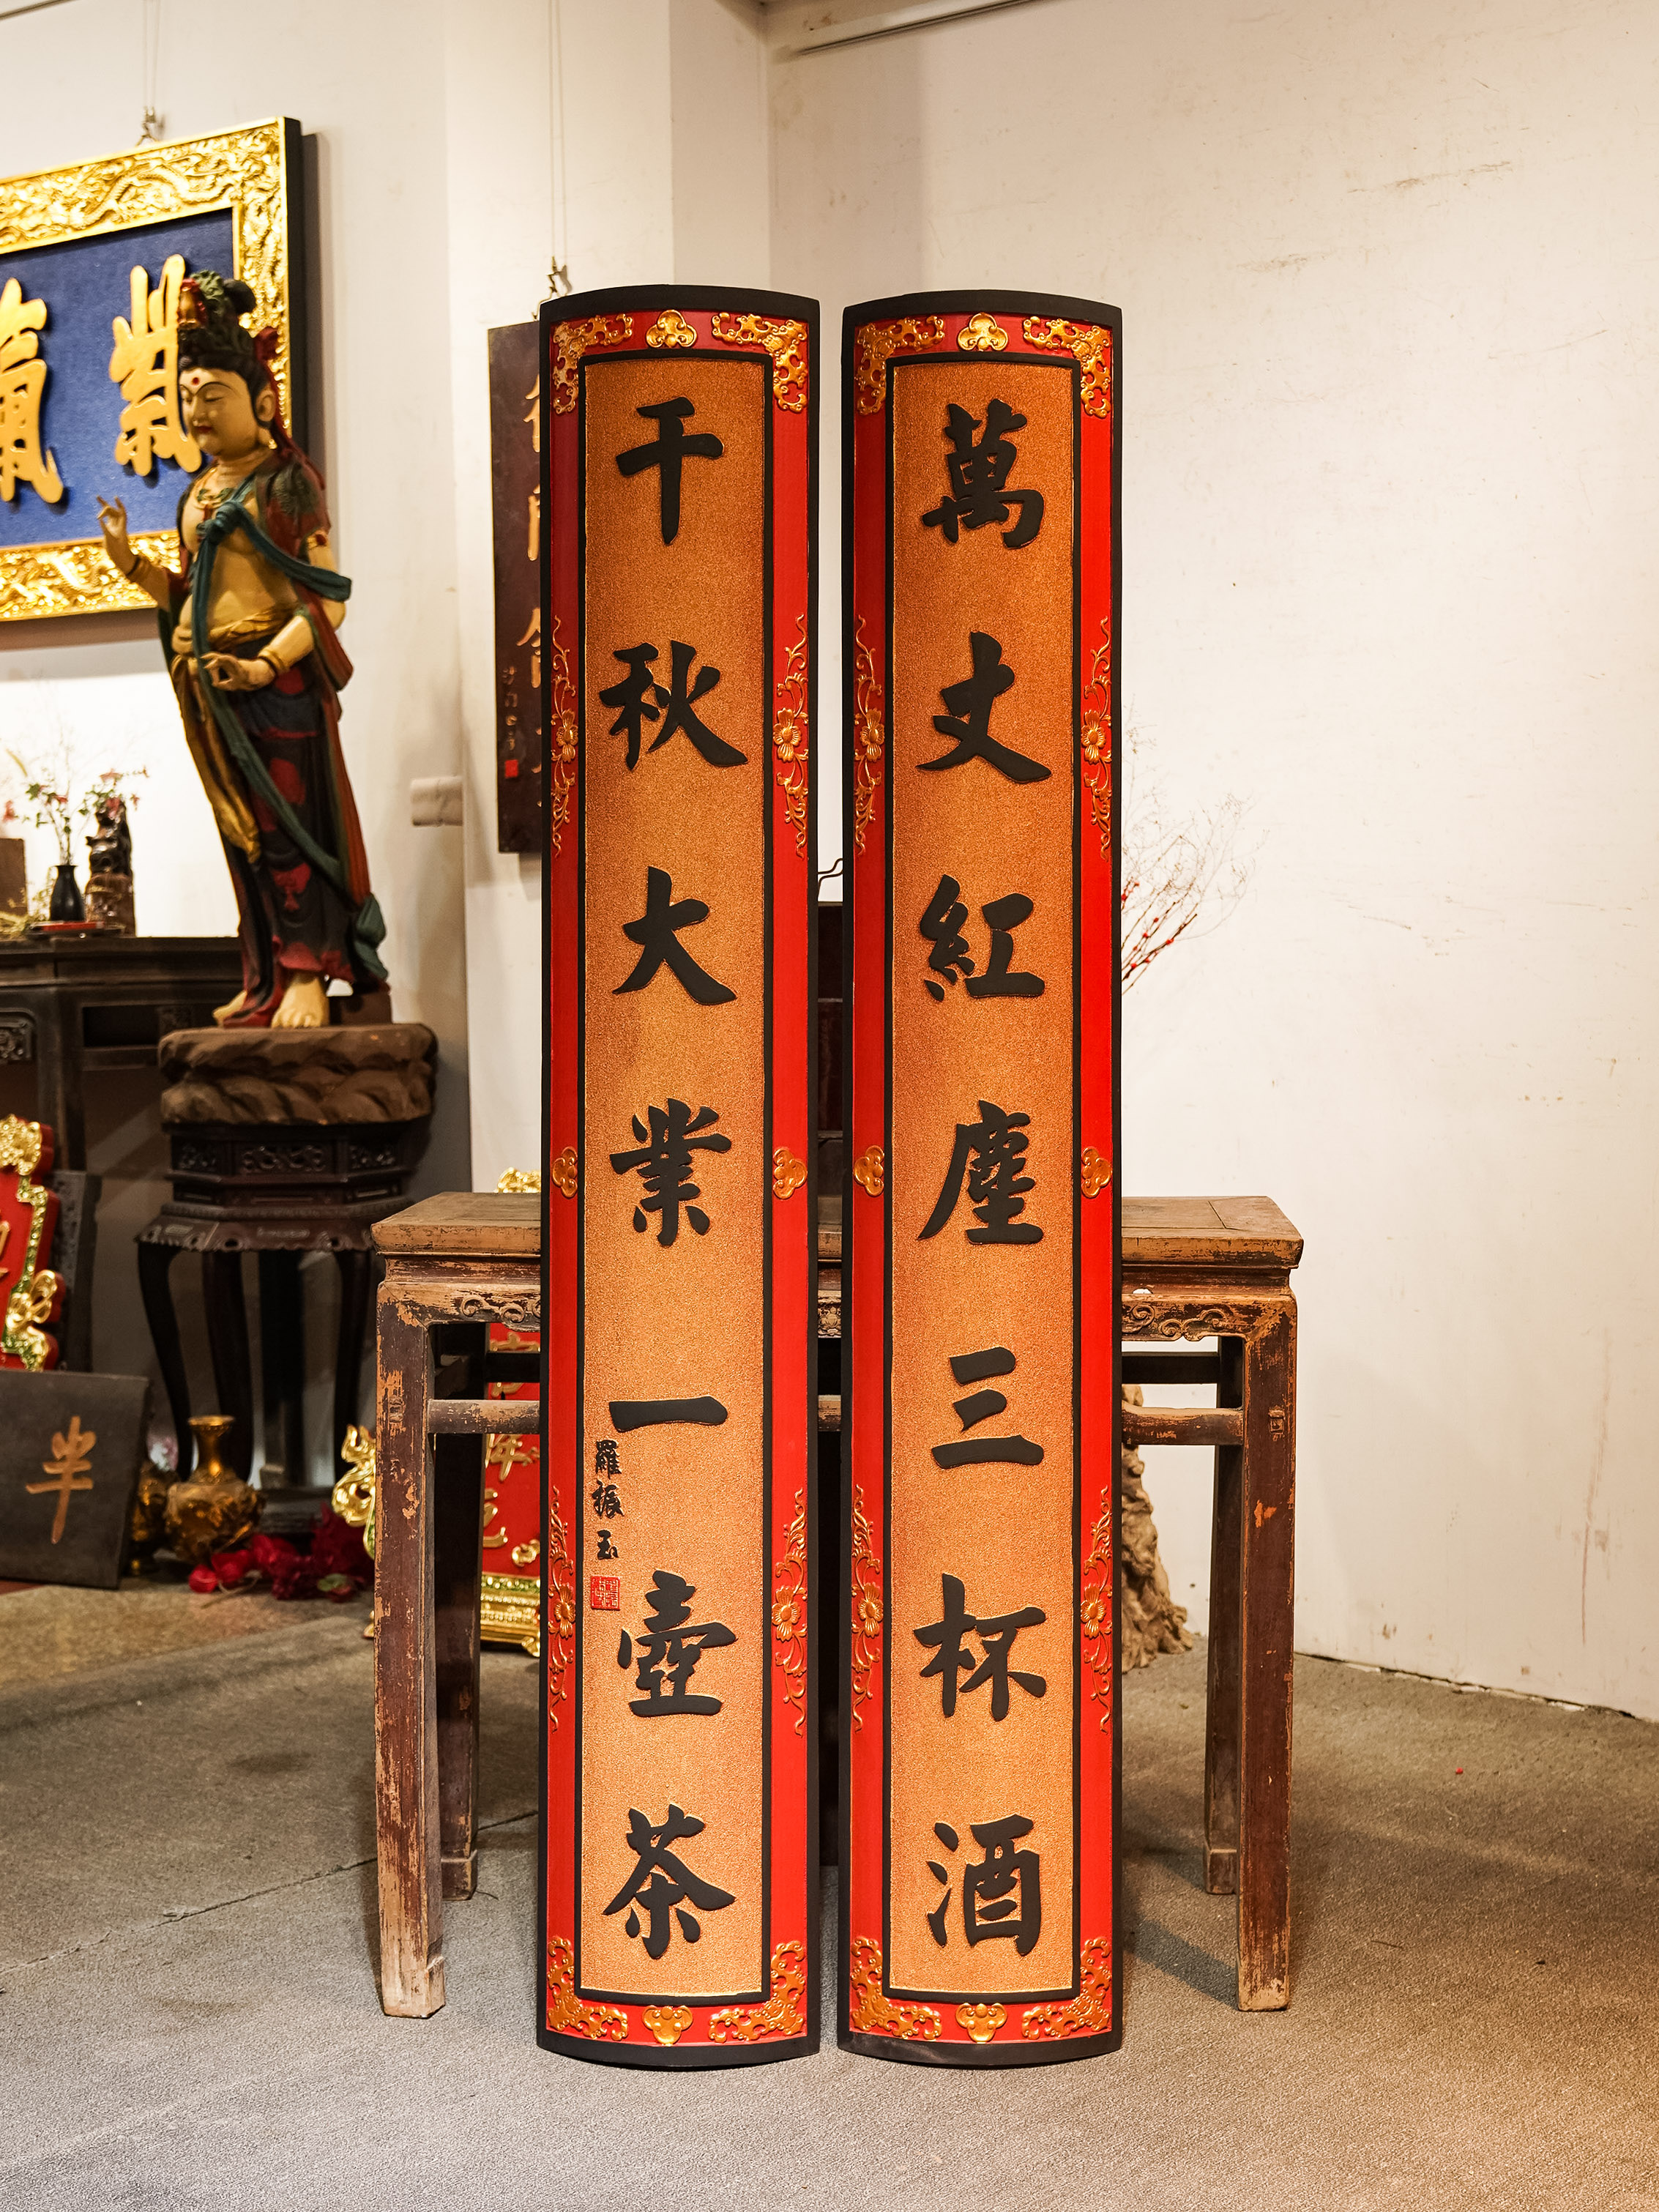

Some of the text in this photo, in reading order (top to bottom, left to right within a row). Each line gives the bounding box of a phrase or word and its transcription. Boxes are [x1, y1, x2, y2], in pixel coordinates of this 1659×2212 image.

[25, 1415, 97, 1544] 半
[591, 1438, 625, 1560] 羅振玉
[598, 396, 748, 1961] 千秋大業一壺茶
[914, 398, 1052, 1956] 萬丈紅塵三杯酒
